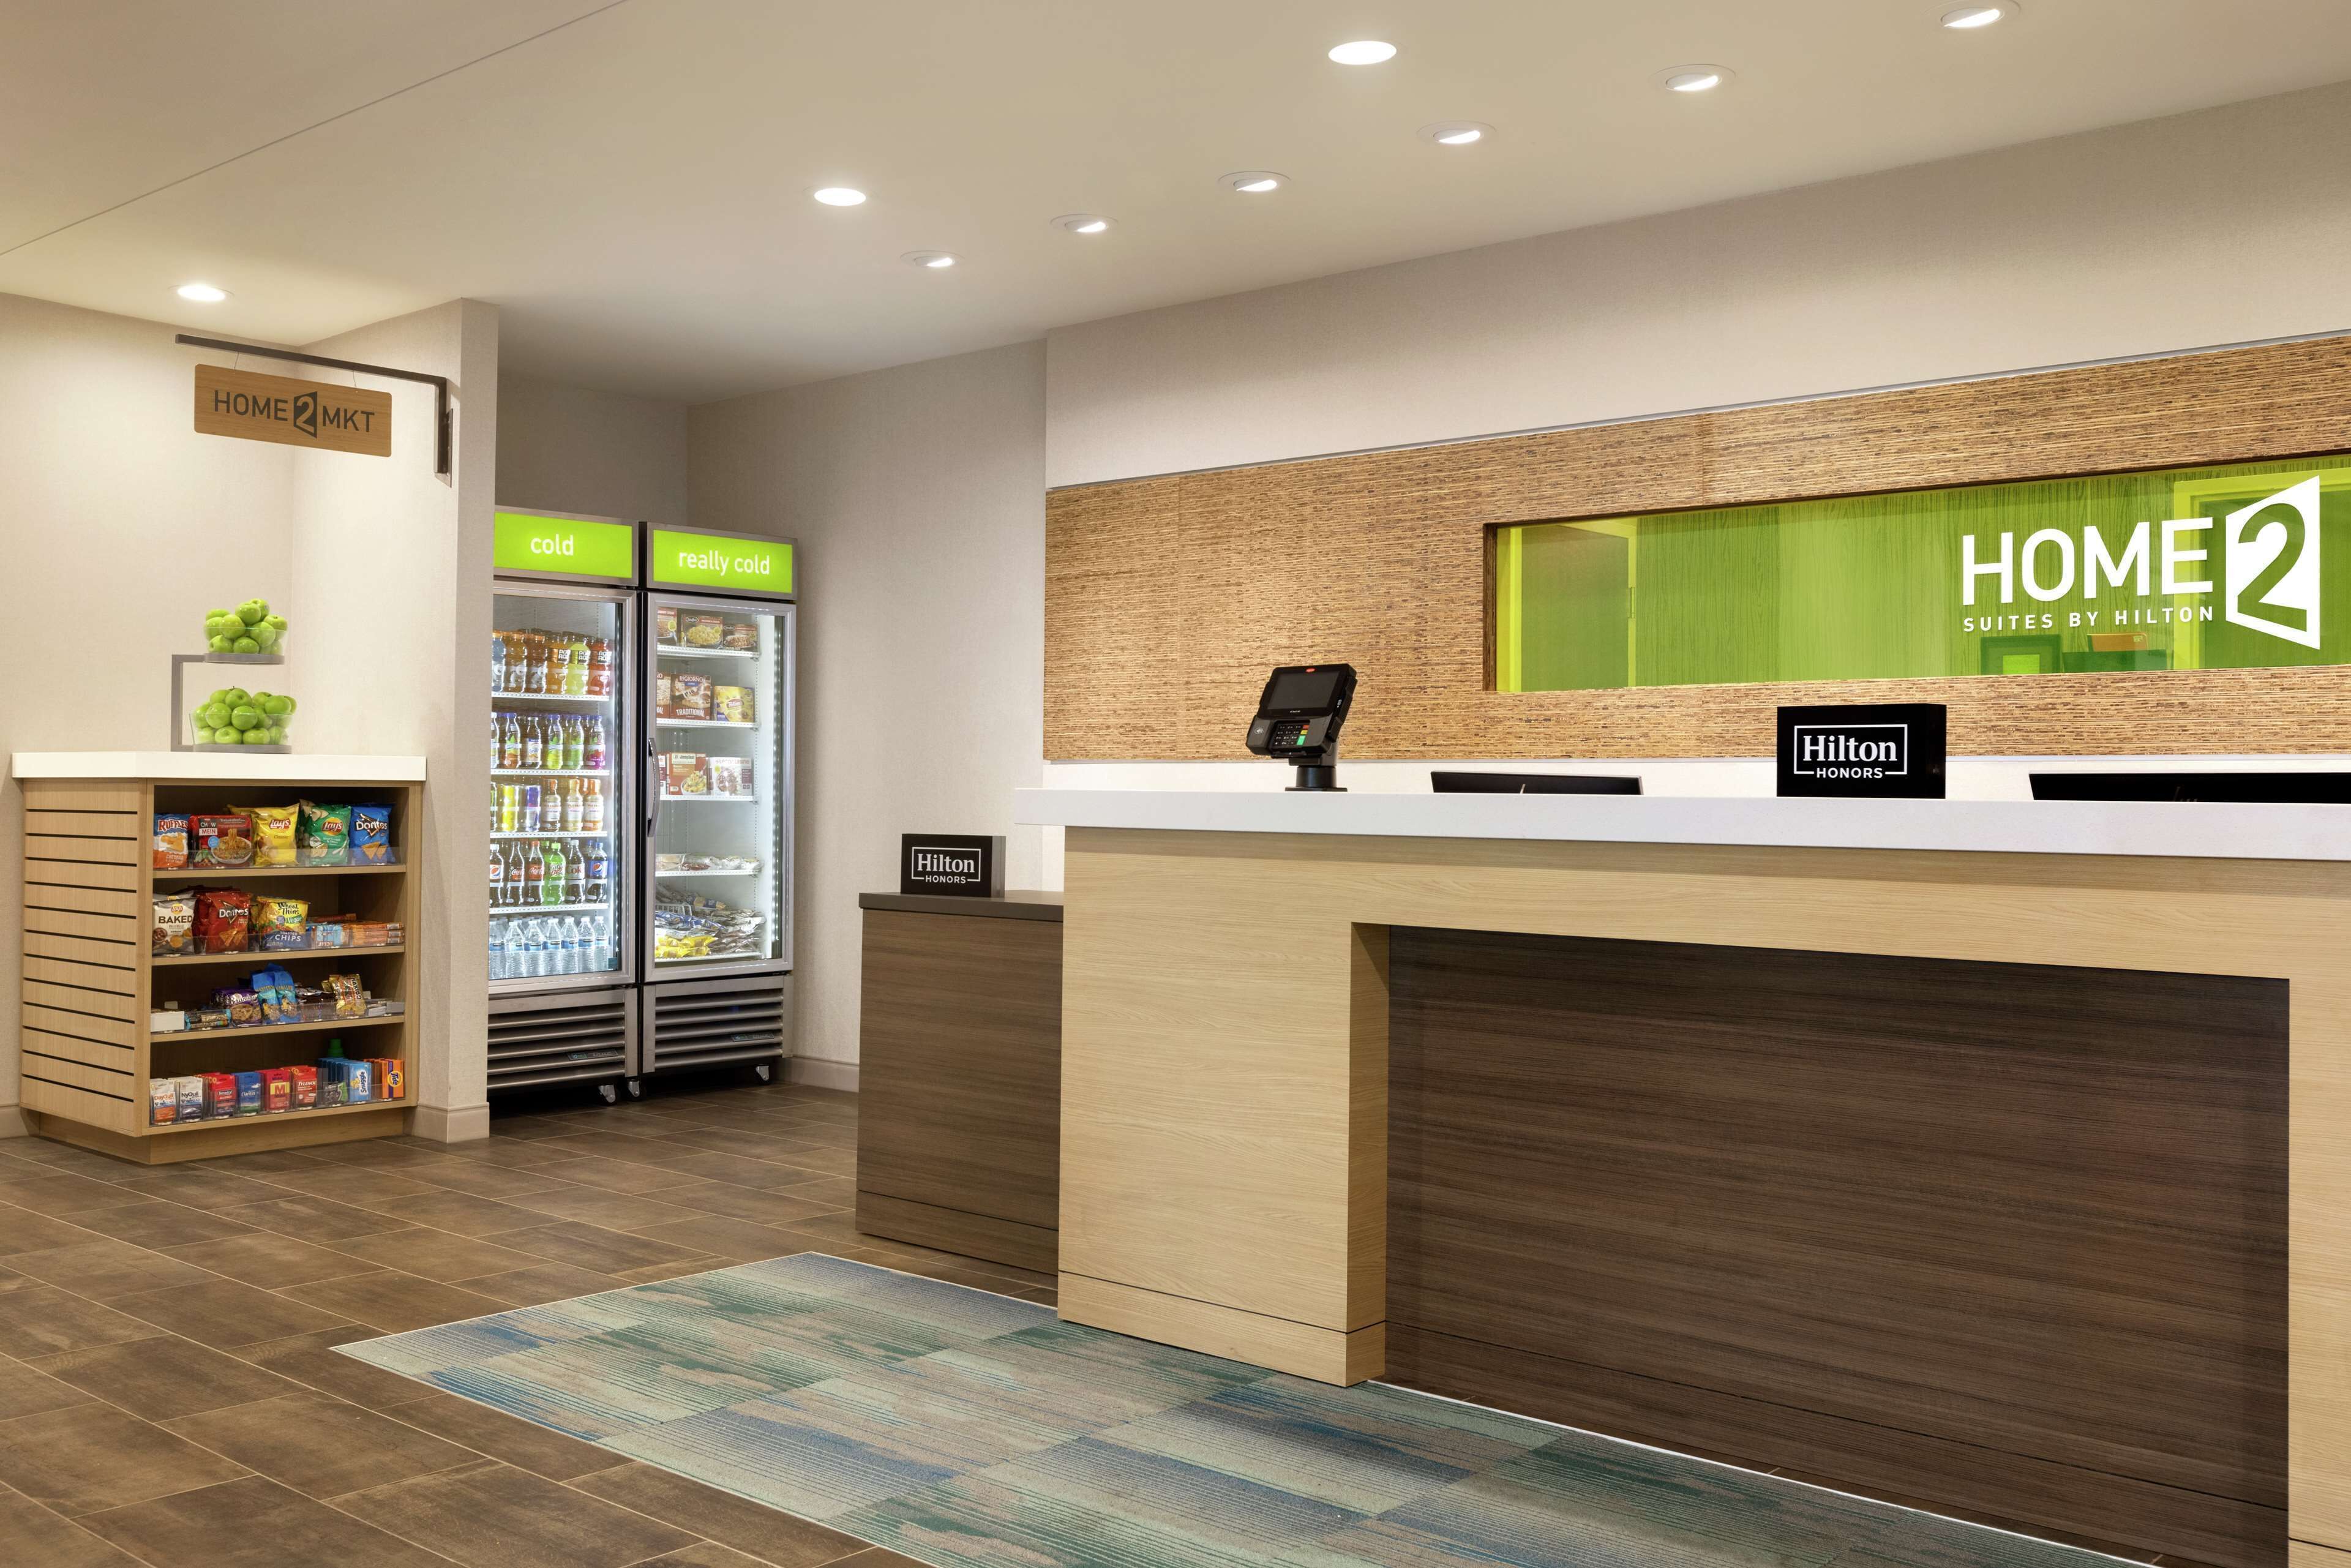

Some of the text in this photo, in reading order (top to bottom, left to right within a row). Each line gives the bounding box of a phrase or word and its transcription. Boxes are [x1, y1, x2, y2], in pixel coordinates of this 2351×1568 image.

[214, 390, 288, 422] HOME
[323, 405, 375, 432] MKT
[530, 533, 574, 556] cold
[679, 549, 770, 576] really cold
[1963, 517, 2213, 606] HOME
[1963, 606, 2214, 632] SUITES BY HILTON
[676, 708, 705, 717] TRADITIONAL
[1803, 735, 1897, 762] Hilton
[1817, 767, 1883, 779] HONORS
[356, 819, 388, 831] Doritos
[917, 853, 975, 872] Hilton
[925, 875, 966, 883] HONORS
[219, 908, 249, 918] Doritos
[154, 1093, 174, 1101] DayQuil
